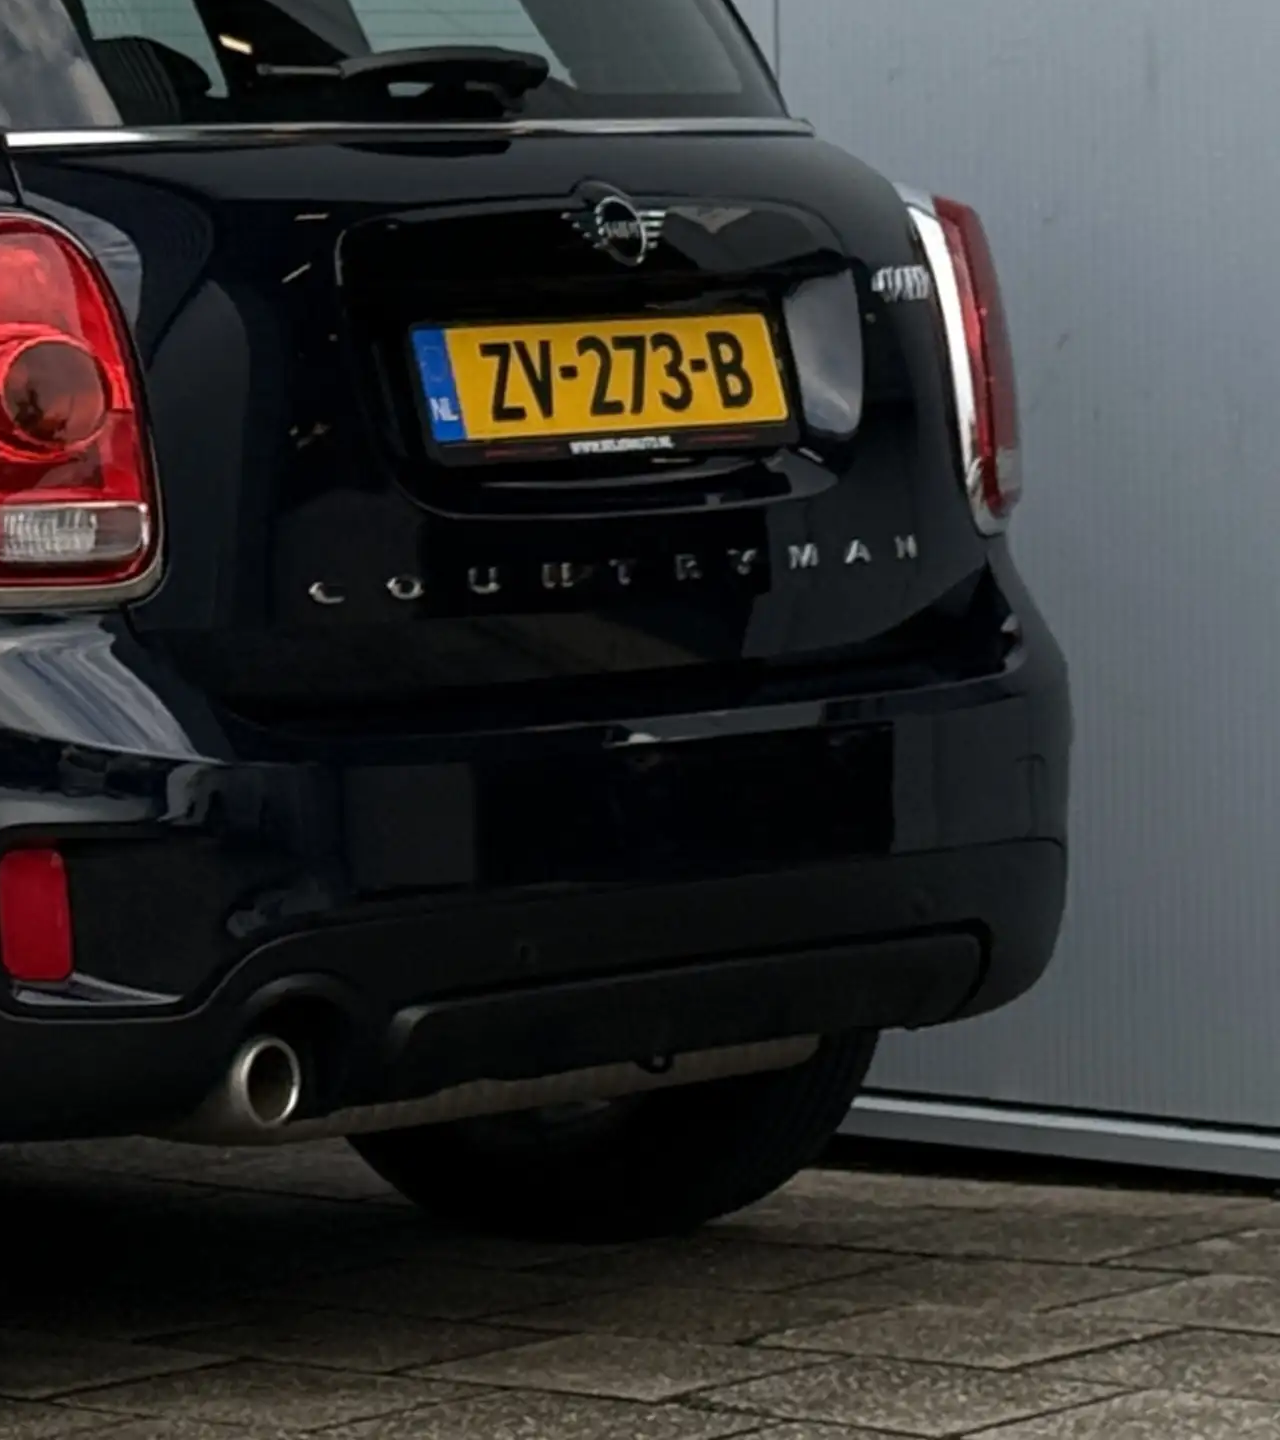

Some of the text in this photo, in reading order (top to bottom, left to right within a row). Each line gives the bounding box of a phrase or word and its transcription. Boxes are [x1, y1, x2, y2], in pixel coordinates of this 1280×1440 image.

[429, 397, 459, 422] NL
[479, 331, 753, 423] ZV-273-B
[307, 534, 920, 605] COUNTRYMAN
